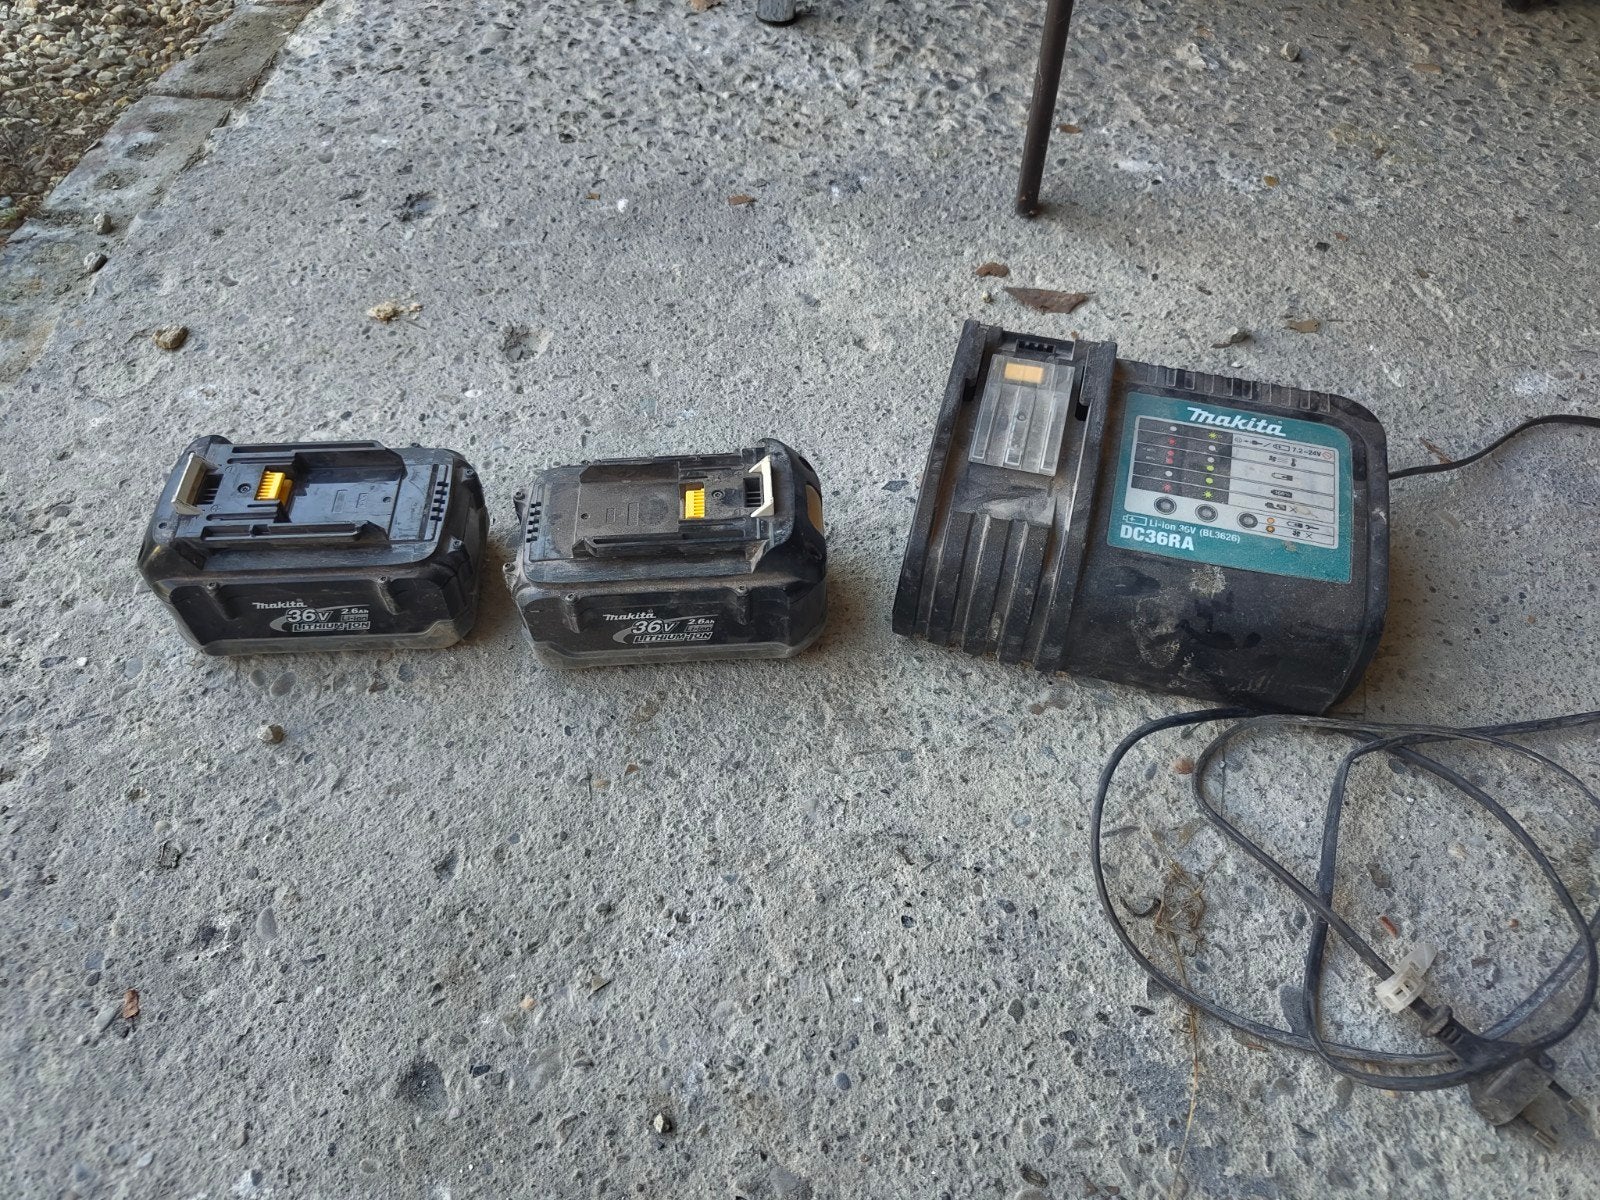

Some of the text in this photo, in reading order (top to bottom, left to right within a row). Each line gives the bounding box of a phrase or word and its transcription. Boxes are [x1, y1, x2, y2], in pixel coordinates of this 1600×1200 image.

[1120, 524, 1194, 551] DC36RA
[1178, 523, 1196, 535] 36V
[1199, 527, 1241, 544] (BL3626)
[287, 609, 332, 622] 36V
[632, 620, 677, 633] 36V
